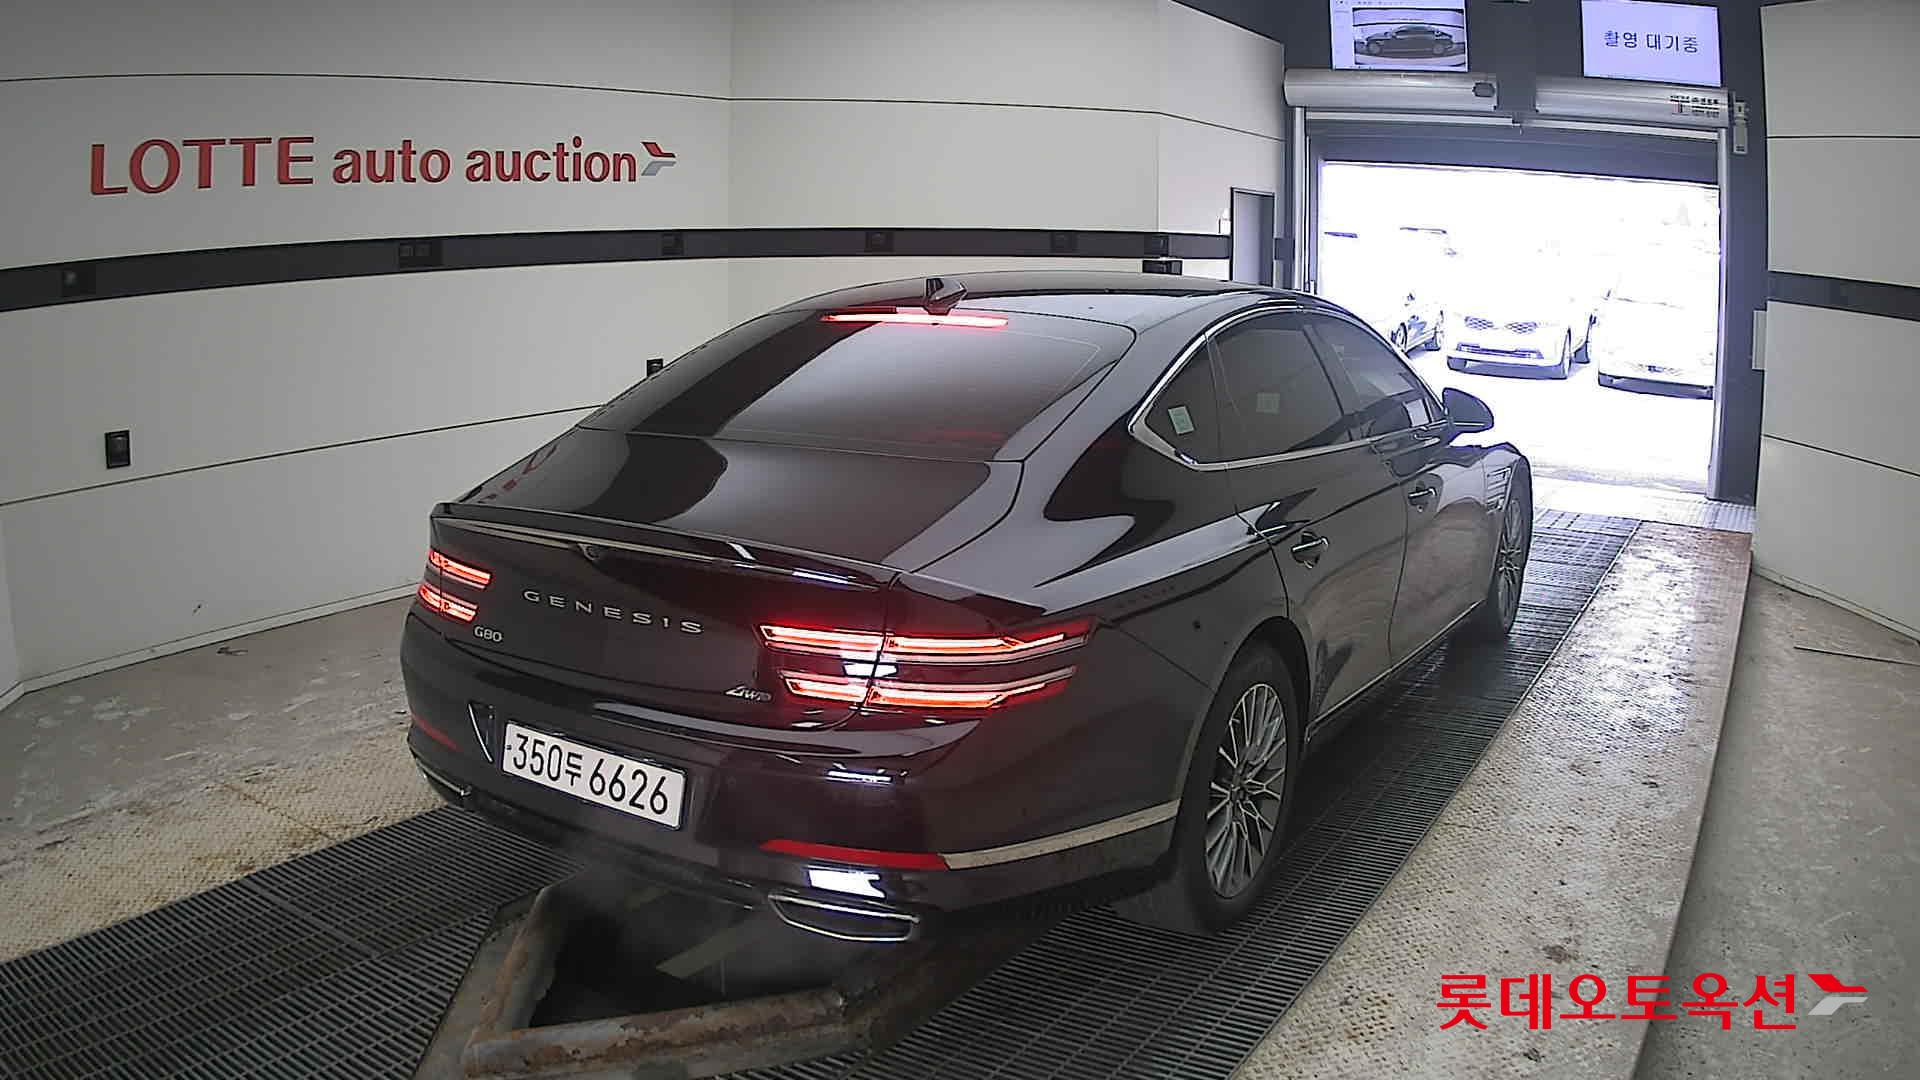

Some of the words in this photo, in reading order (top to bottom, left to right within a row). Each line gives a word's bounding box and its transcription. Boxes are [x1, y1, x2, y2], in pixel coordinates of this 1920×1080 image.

[1646, 33, 1698, 53] 대기중
[90, 137, 314, 196] LOTTE
[332, 139, 451, 184] auto
[465, 136, 638, 183] auction
[474, 625, 503, 643] G80
[523, 589, 703, 634] GENESIS
[589, 758, 668, 815] 6626
